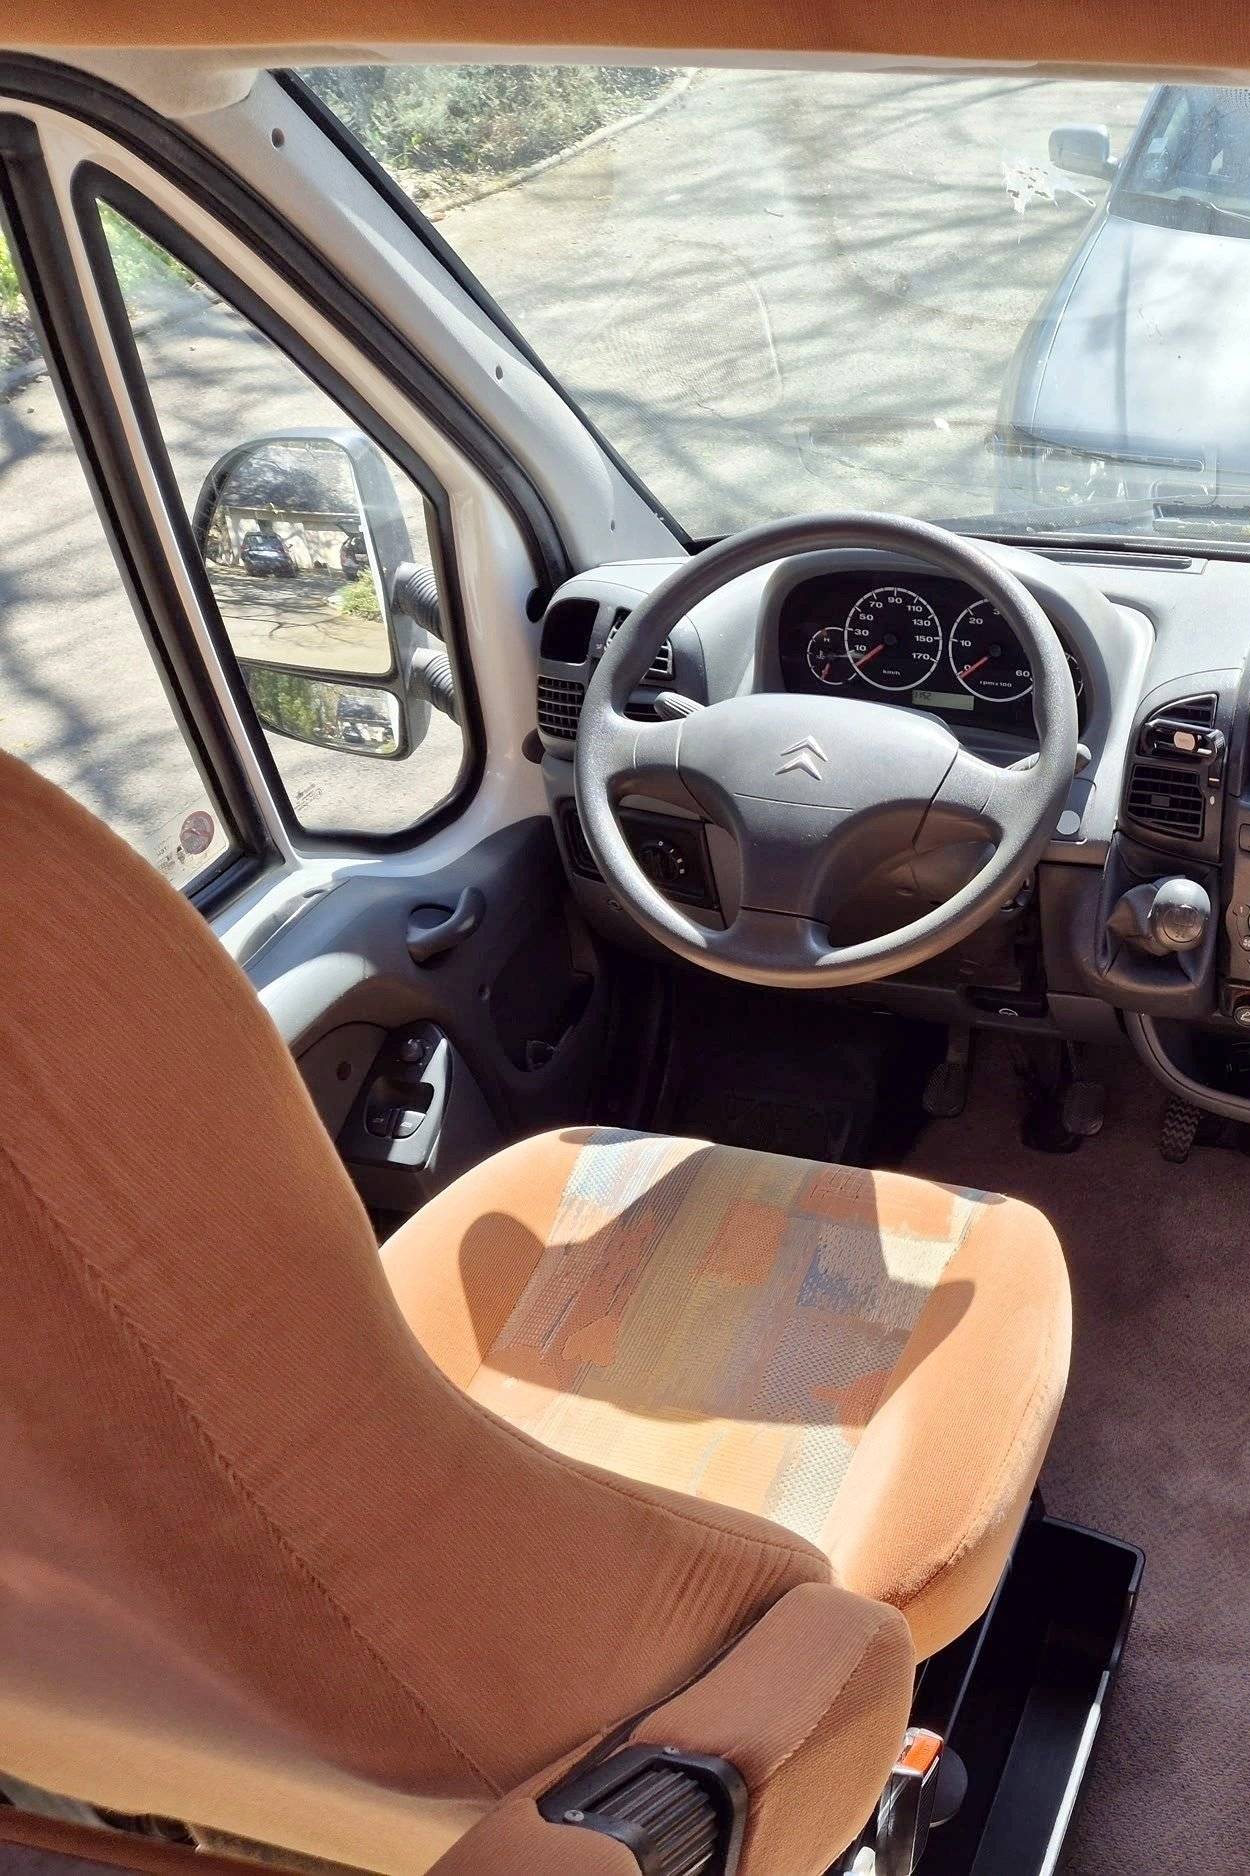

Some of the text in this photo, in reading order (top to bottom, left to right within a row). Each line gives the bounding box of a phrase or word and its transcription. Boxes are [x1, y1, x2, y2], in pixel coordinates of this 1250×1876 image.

[887, 596, 903, 604] 90
[869, 601, 883, 609] 70
[906, 605, 923, 613] 110
[859, 613, 874, 621] 50
[968, 617, 984, 625] 20
[911, 618, 931, 627] 130
[854, 628, 869, 636] 30
[914, 635, 934, 643] 150
[911, 652, 931, 660] 170
[1015, 669, 1031, 677] 60
